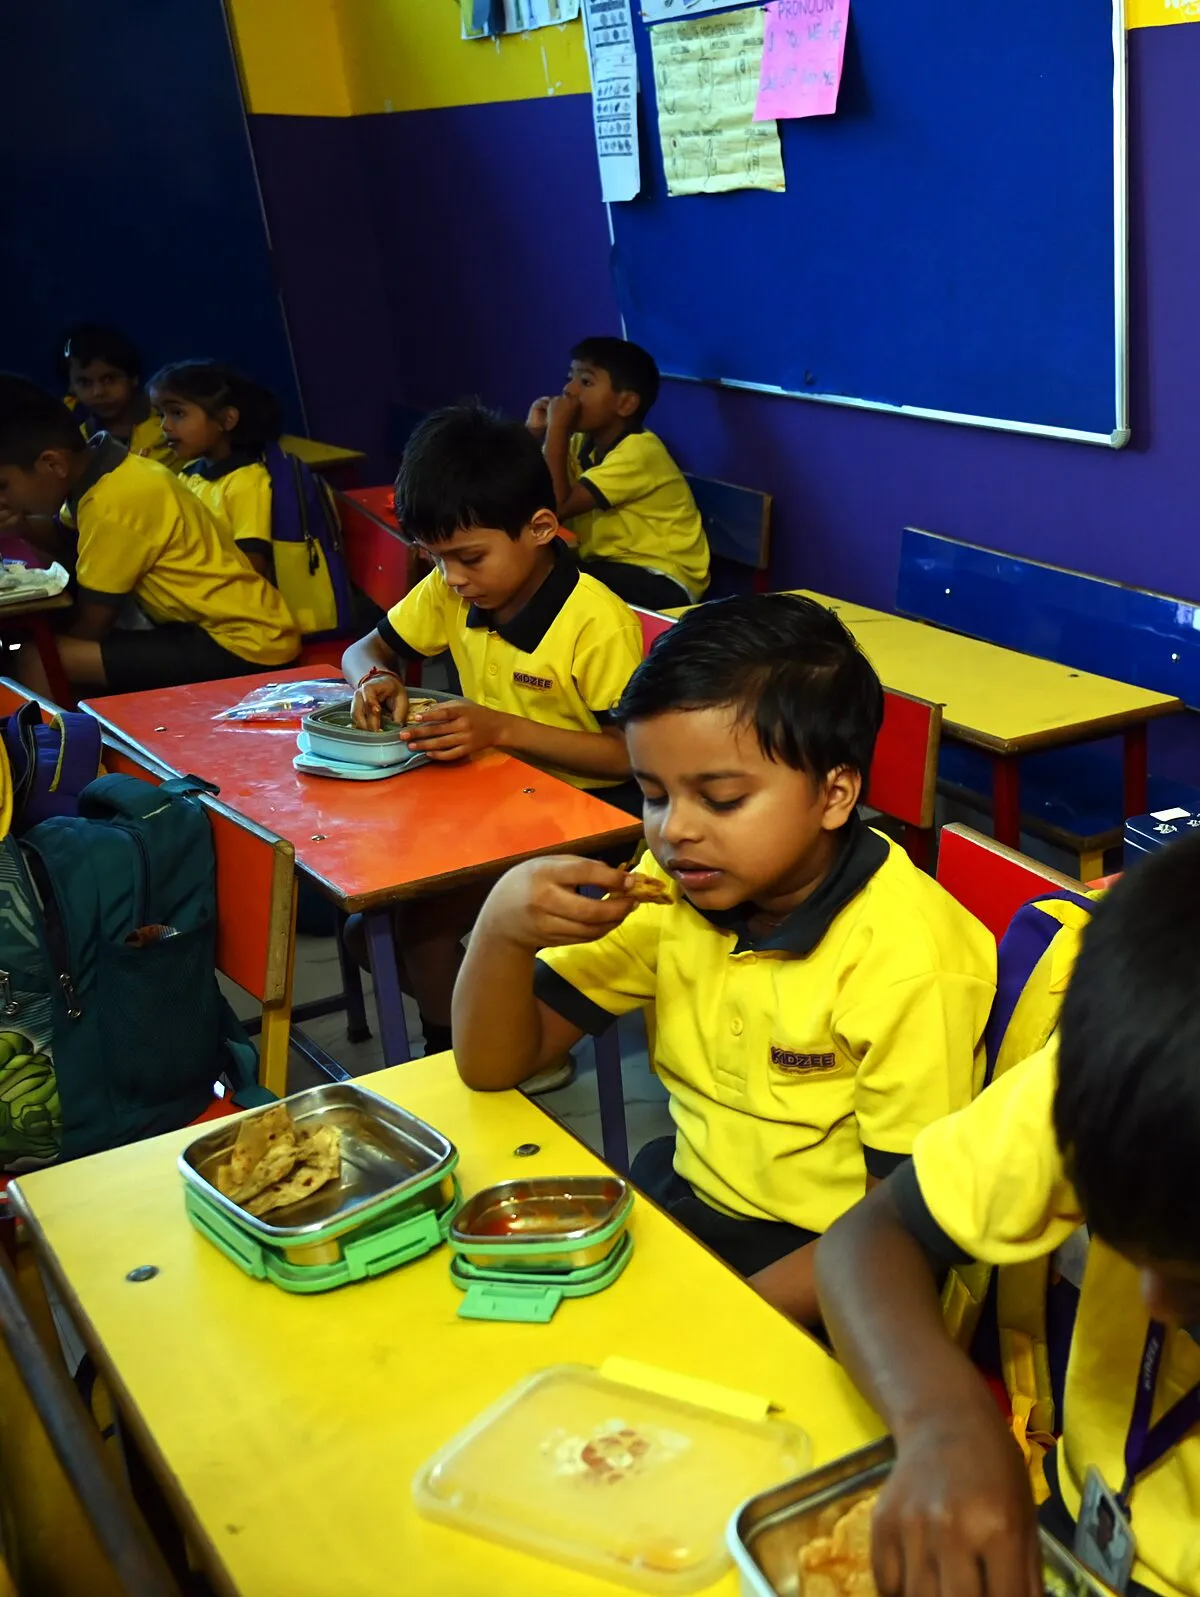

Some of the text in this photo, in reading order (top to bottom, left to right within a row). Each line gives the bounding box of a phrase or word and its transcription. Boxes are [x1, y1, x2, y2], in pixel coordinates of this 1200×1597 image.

[778, 0, 834, 19] PRONOUN
[512, 672, 554, 690] KIDZEE
[771, 1046, 836, 1069] KIDZEE
